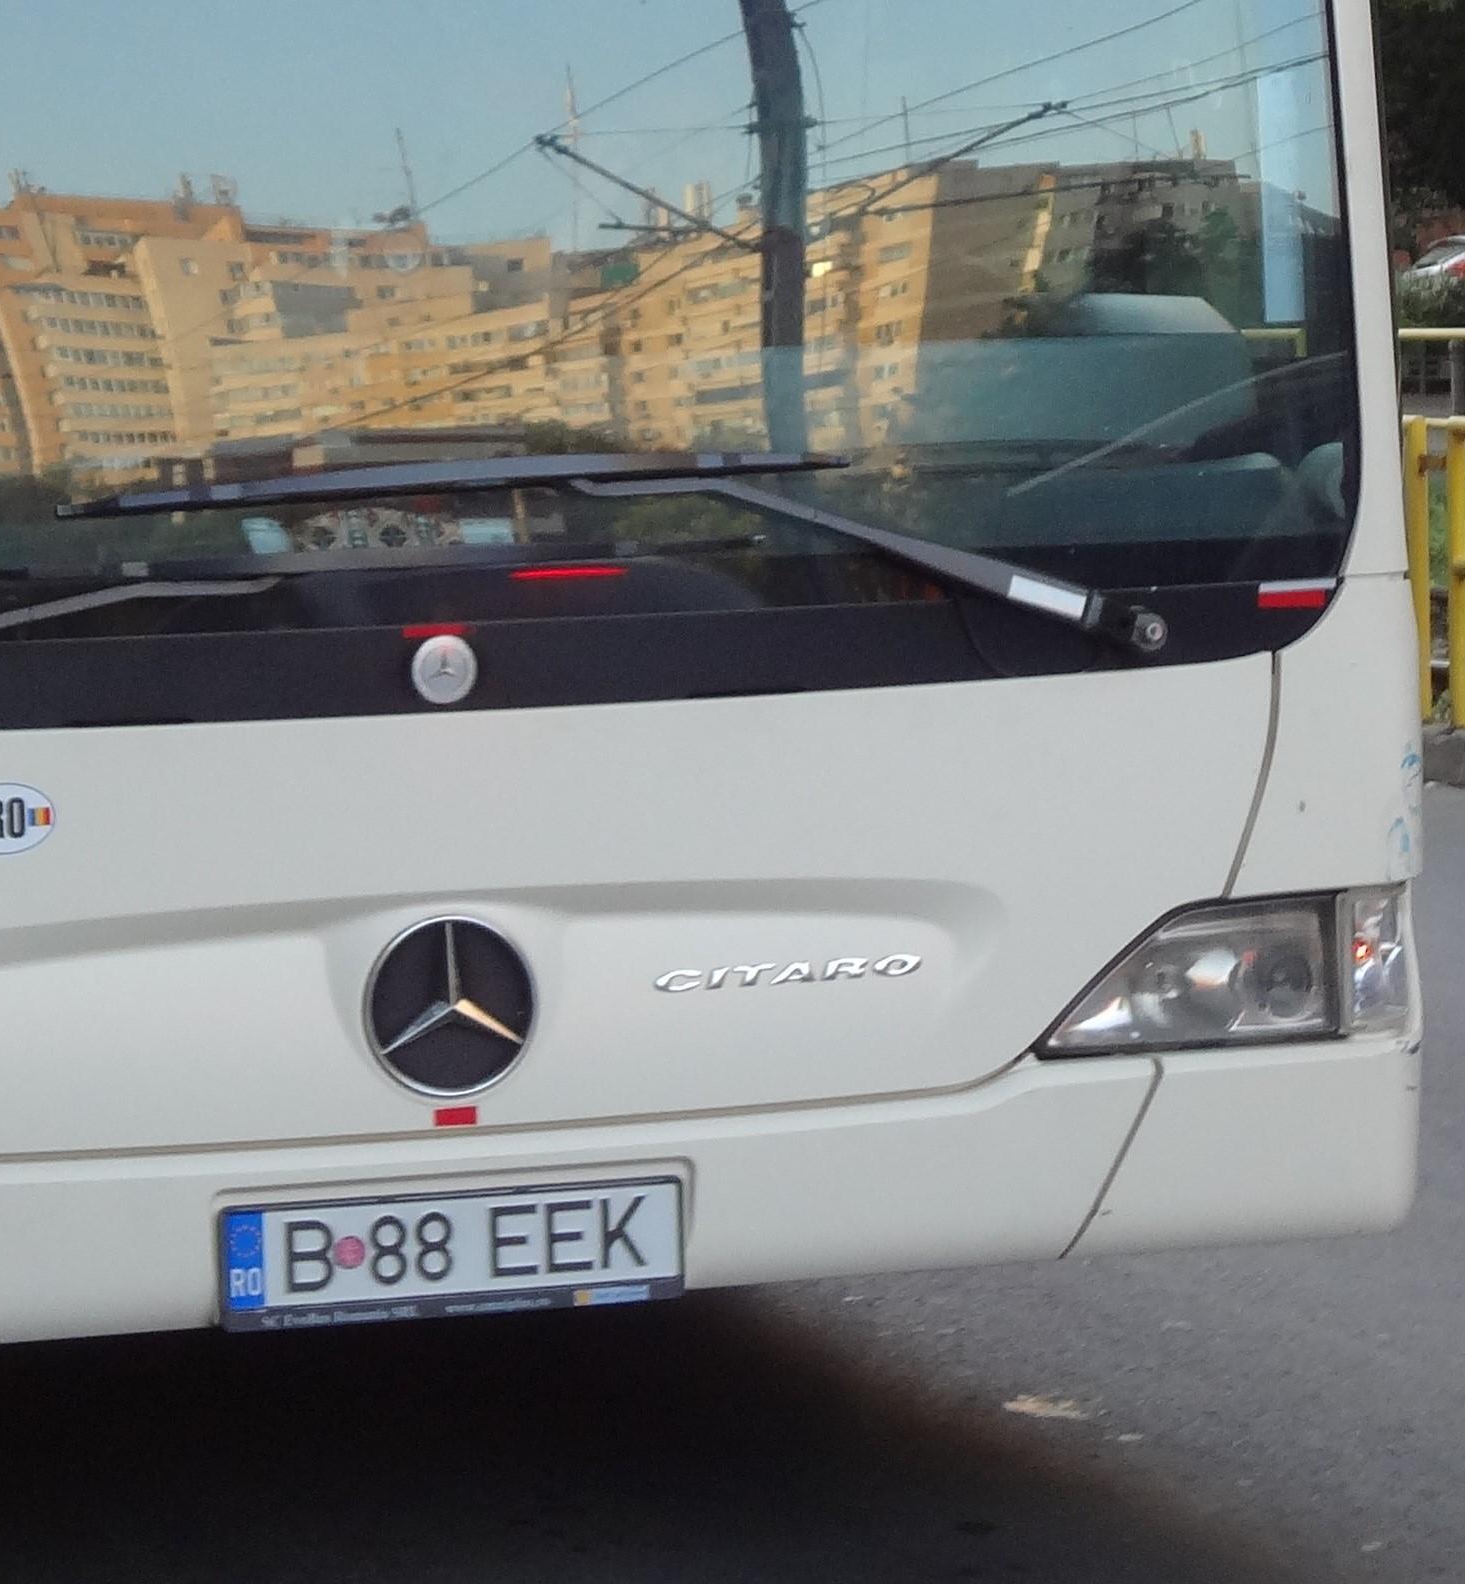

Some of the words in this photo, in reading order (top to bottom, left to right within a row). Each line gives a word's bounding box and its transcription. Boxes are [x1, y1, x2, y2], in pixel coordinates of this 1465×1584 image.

[653, 953, 923, 992] CITARO
[285, 1219, 334, 1294] B
[369, 1210, 454, 1287] 88
[488, 1193, 648, 1279] EEK
[229, 1267, 264, 1298] RO
